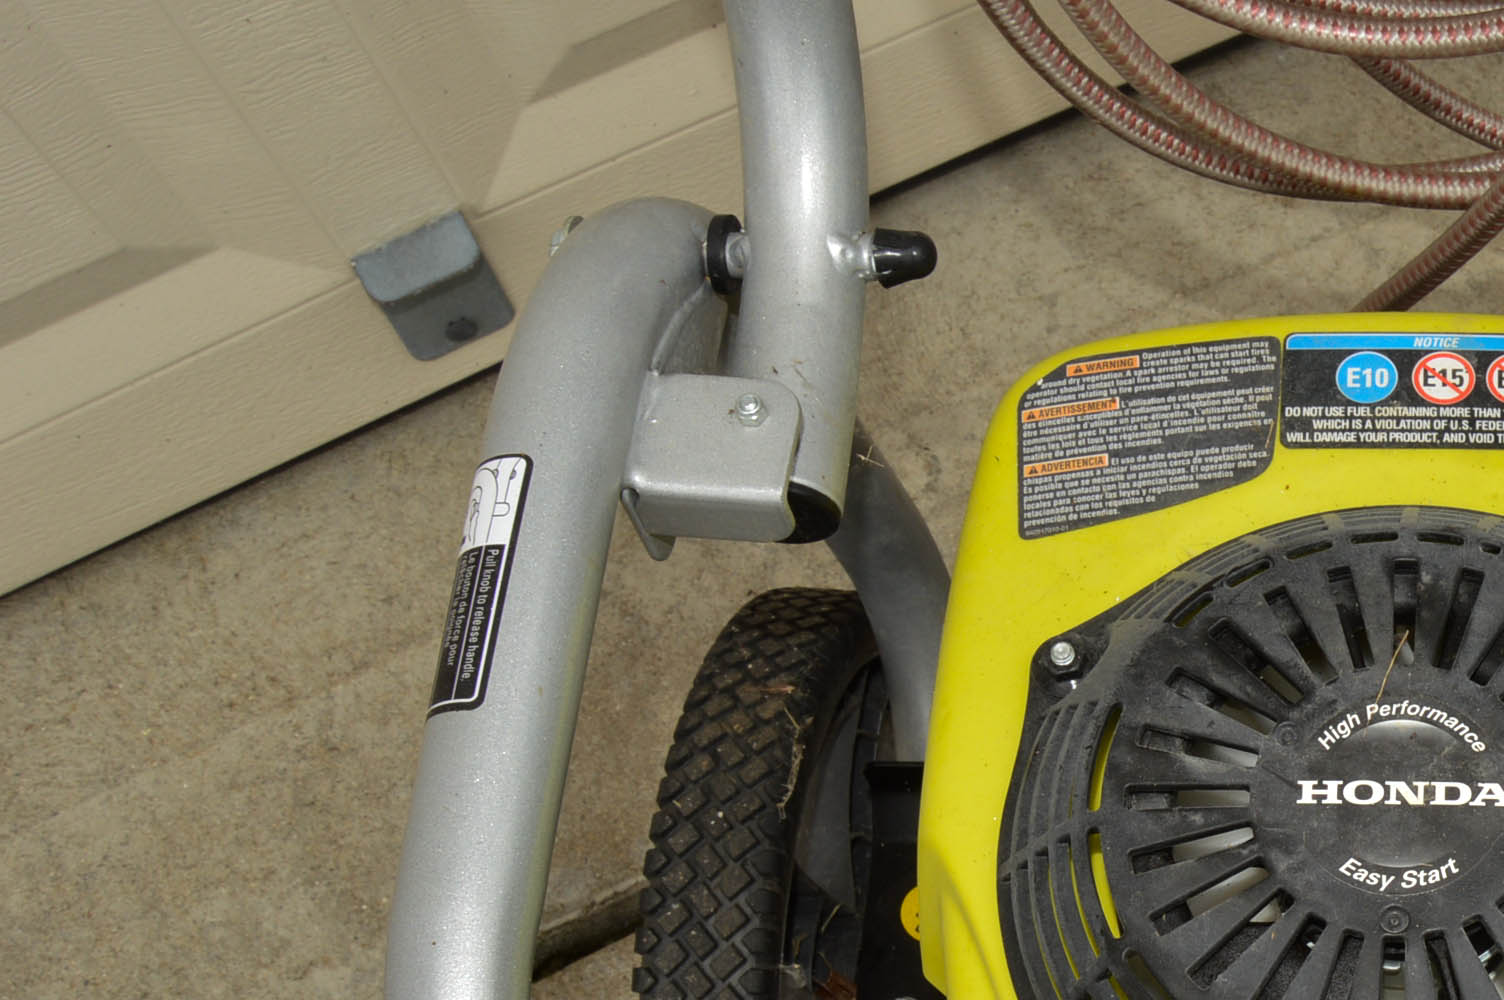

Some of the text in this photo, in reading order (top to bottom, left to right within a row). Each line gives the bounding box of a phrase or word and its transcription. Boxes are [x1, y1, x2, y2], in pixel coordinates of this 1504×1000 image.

[1413, 337, 1459, 348] NOTICE
[1086, 358, 1134, 371] WARNING
[1346, 368, 1389, 388] E10
[1422, 368, 1464, 389] E15
[1039, 400, 1112, 416] AVERTISSEMENT
[1285, 406, 1300, 416] DO
[1302, 406, 1323, 416] NOT
[1325, 406, 1345, 416] USE
[1347, 406, 1373, 416] FUEL
[1375, 406, 1437, 417] CONTAINING
[1440, 407, 1470, 417] MORE
[1472, 408, 1500, 418] THAN
[1312, 420, 1349, 429] WHICH
[1352, 420, 1362, 429] IS
[1364, 420, 1373, 429] A
[1375, 420, 1430, 430] VIOLATION
[1434, 420, 1448, 430] OF
[1450, 420, 1472, 430] U.S.
[1286, 432, 1312, 442] WILL
[1314, 432, 1357, 442] DAMAGE
[1359, 432, 1387, 442] YOUR
[1389, 432, 1440, 444] PRODUCT,
[1443, 433, 1465, 443] AND
[1468, 433, 1494, 443] VOID
[1042, 456, 1104, 472] ADVERTENCIA
[485, 549, 499, 566] Pull
[480, 569, 495, 592] knob
[477, 595, 488, 604] to
[468, 606, 485, 642] release
[1318, 700, 1486, 752] High Performance
[1338, 858, 1460, 891] Easy Start
